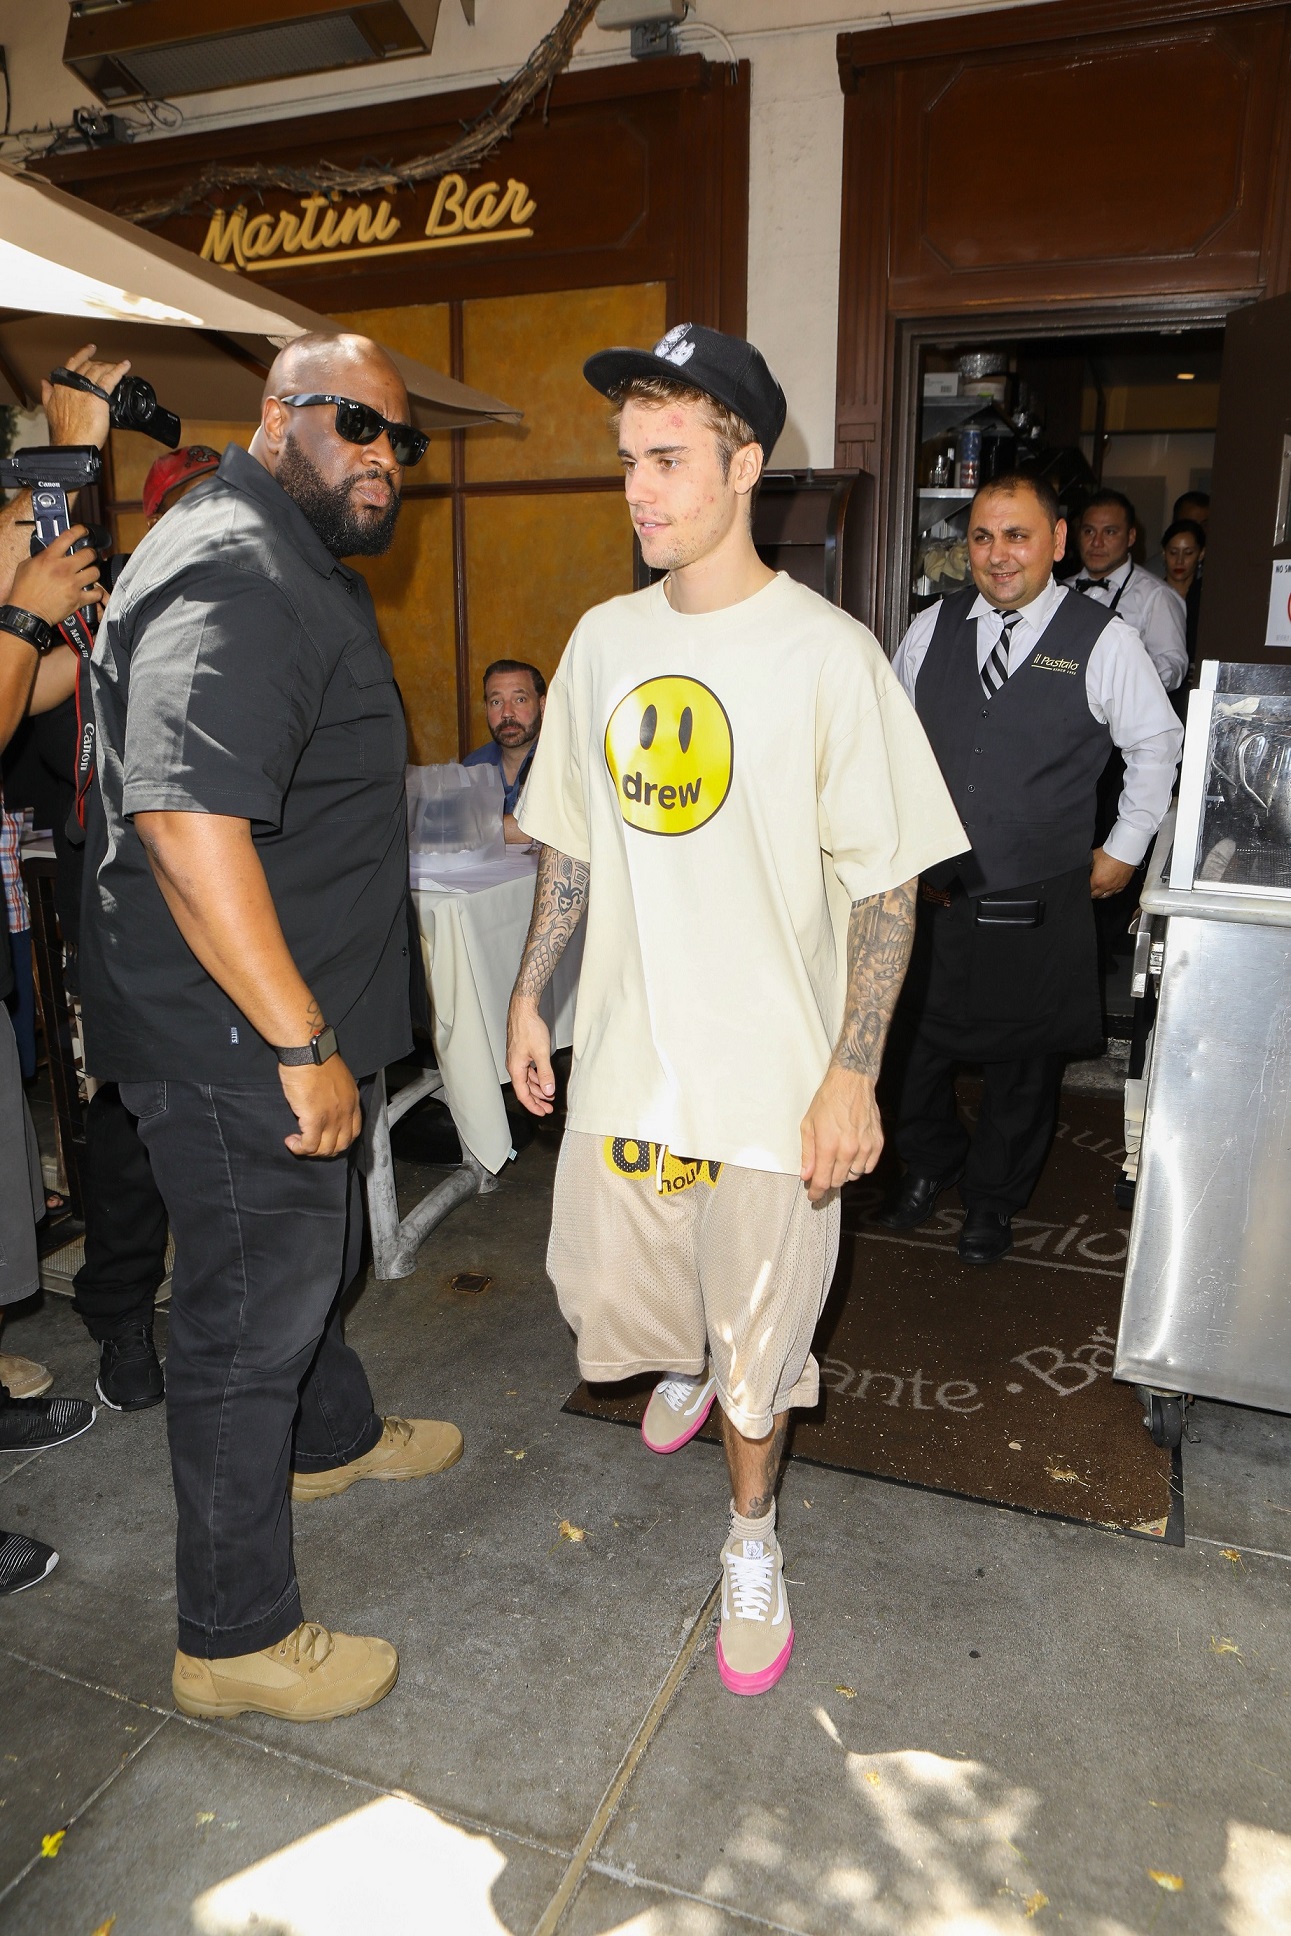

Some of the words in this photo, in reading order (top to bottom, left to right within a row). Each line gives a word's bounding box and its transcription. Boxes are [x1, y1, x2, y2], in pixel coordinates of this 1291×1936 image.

[200, 184, 400, 268] Martini
[425, 173, 537, 237] Bar
[37, 480, 61, 488] Canon
[69, 628, 86, 650] Mark
[80, 722, 95, 771] Canon
[622, 771, 702, 810] drew
[658, 1168, 696, 1195] hou
